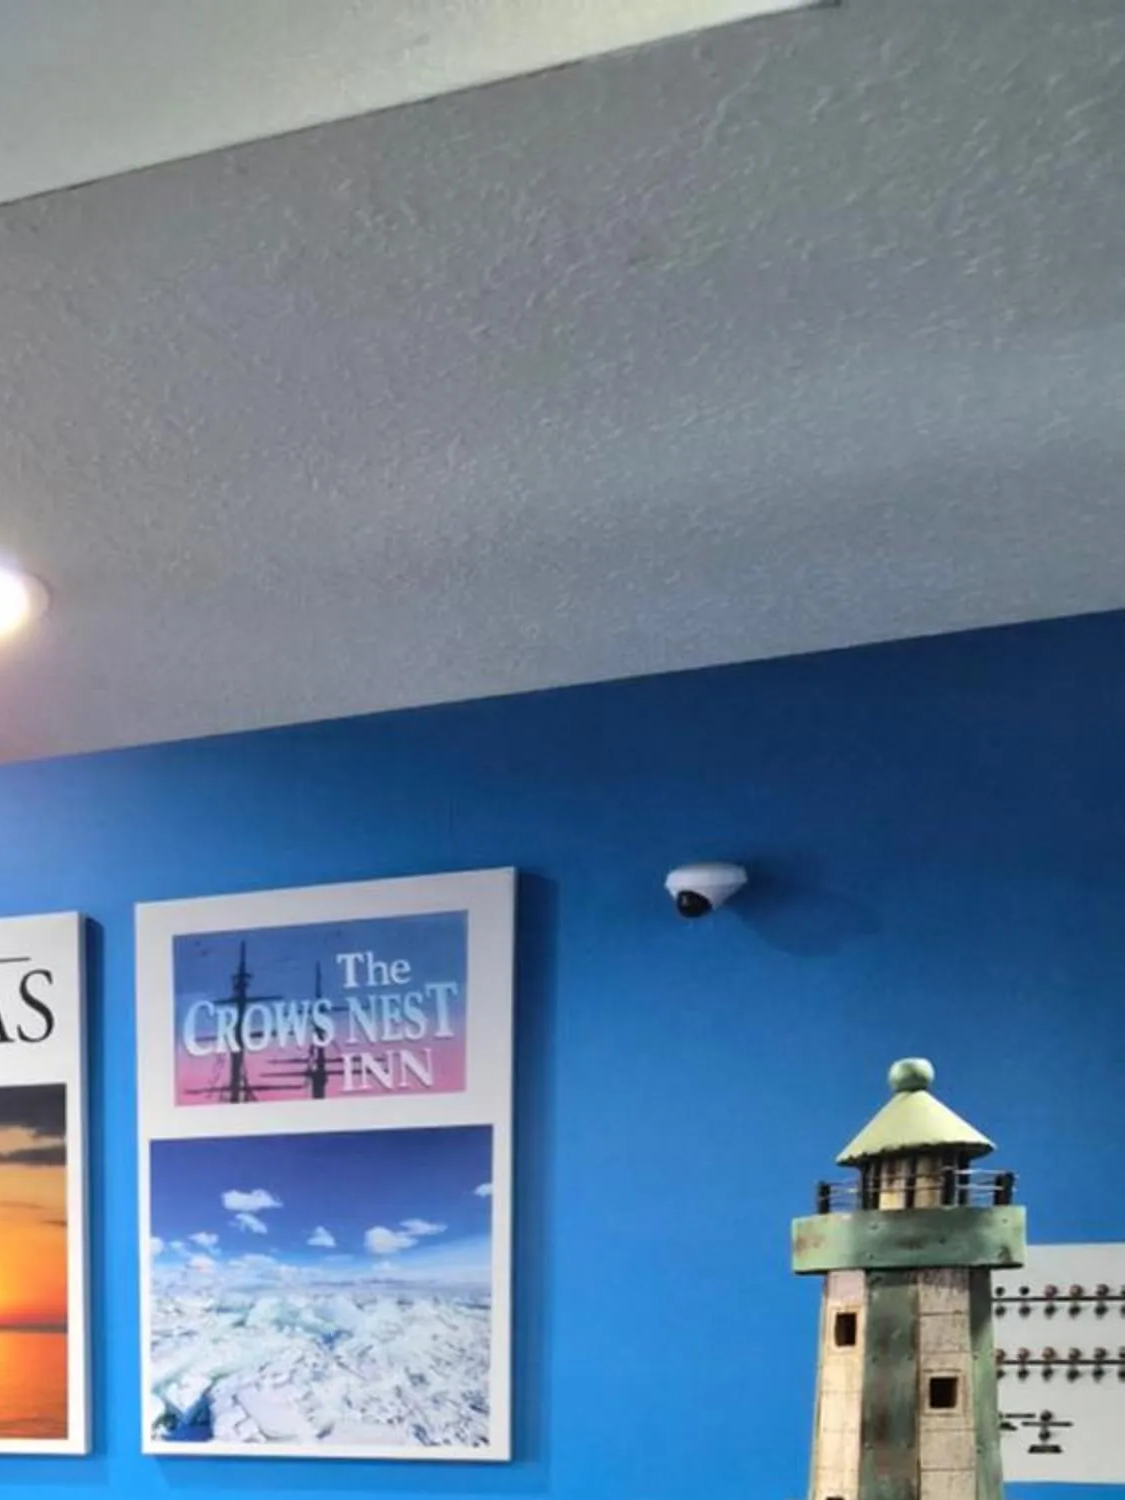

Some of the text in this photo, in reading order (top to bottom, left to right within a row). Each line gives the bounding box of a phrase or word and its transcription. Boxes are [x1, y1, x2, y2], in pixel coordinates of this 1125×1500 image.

[336, 950, 412, 988] The
[183, 981, 458, 1057] CROWS NEST
[340, 1048, 435, 1093] INN
